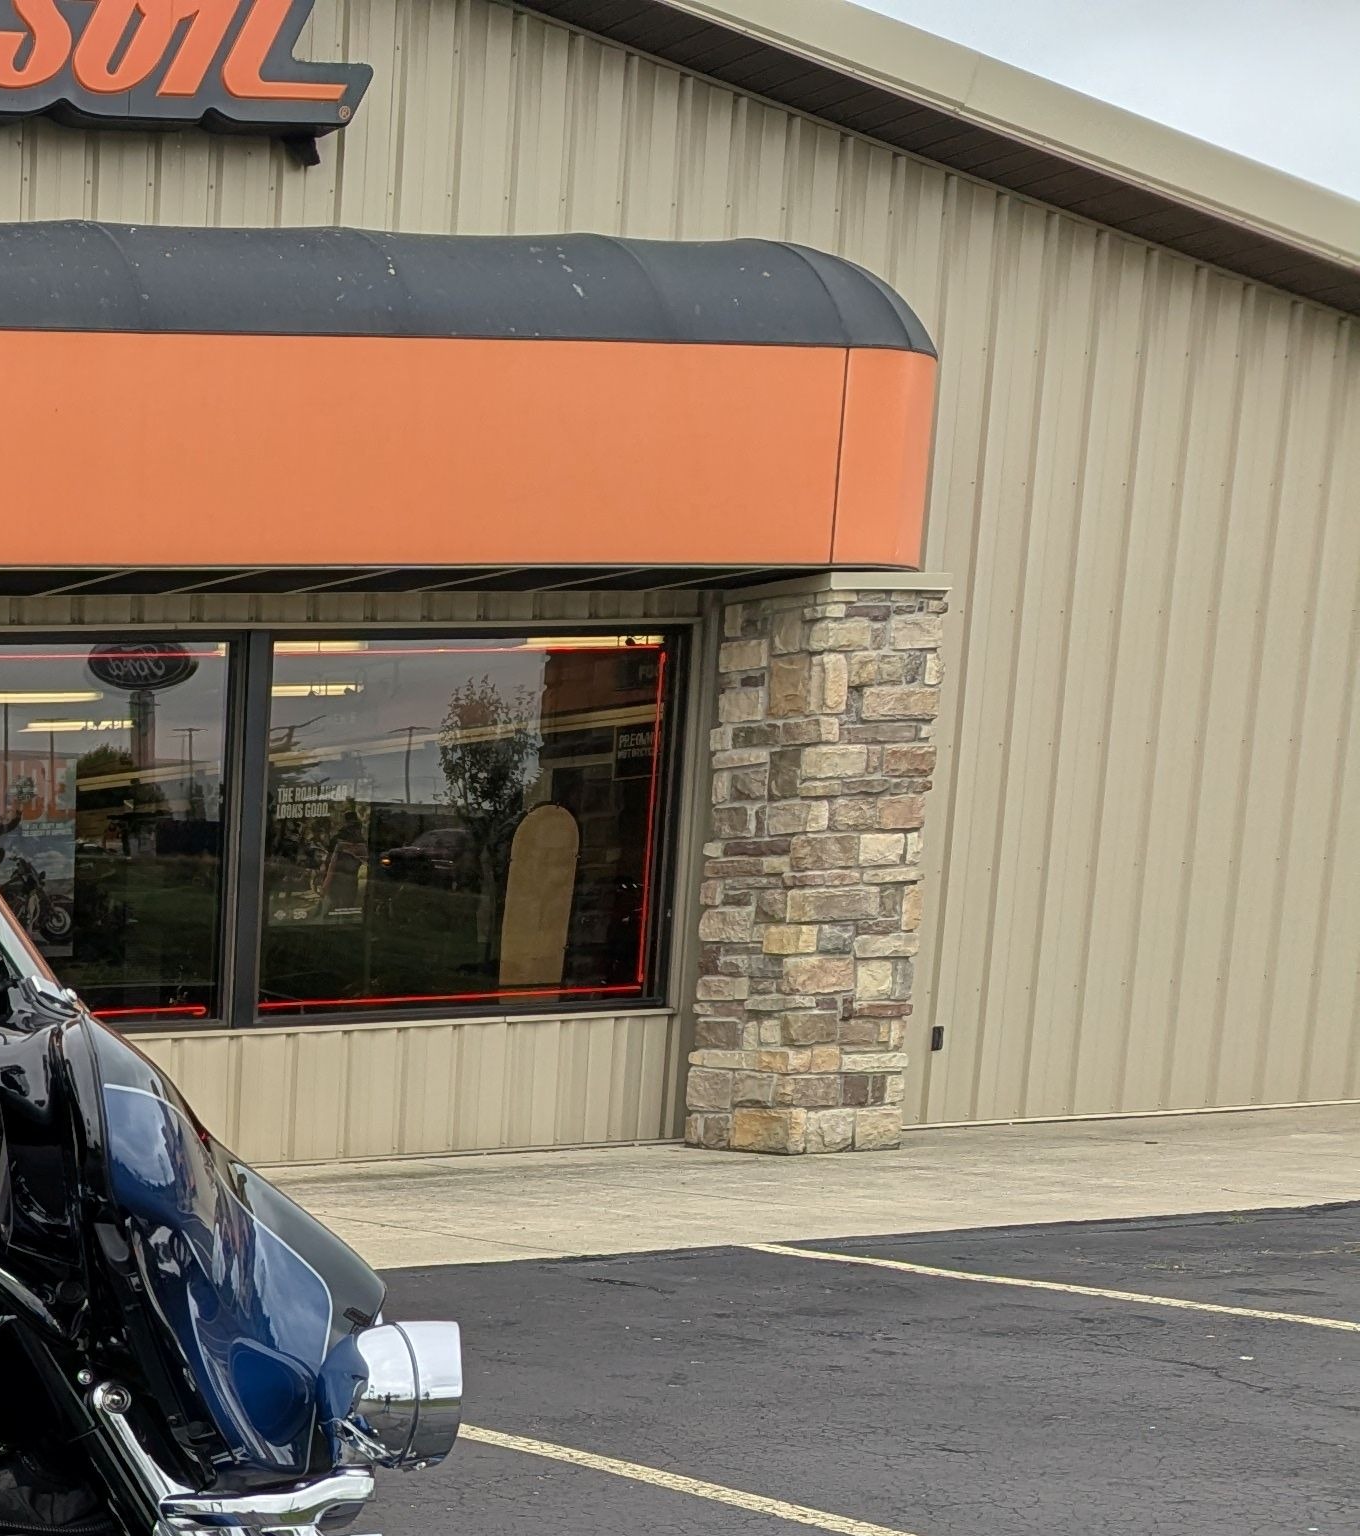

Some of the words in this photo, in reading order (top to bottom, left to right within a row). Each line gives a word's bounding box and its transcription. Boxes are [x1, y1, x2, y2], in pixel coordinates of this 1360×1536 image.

[277, 787, 294, 803] THE
[295, 786, 318, 801] ROAD
[276, 803, 304, 819] LOOKS
[305, 802, 330, 818] GOOD.
